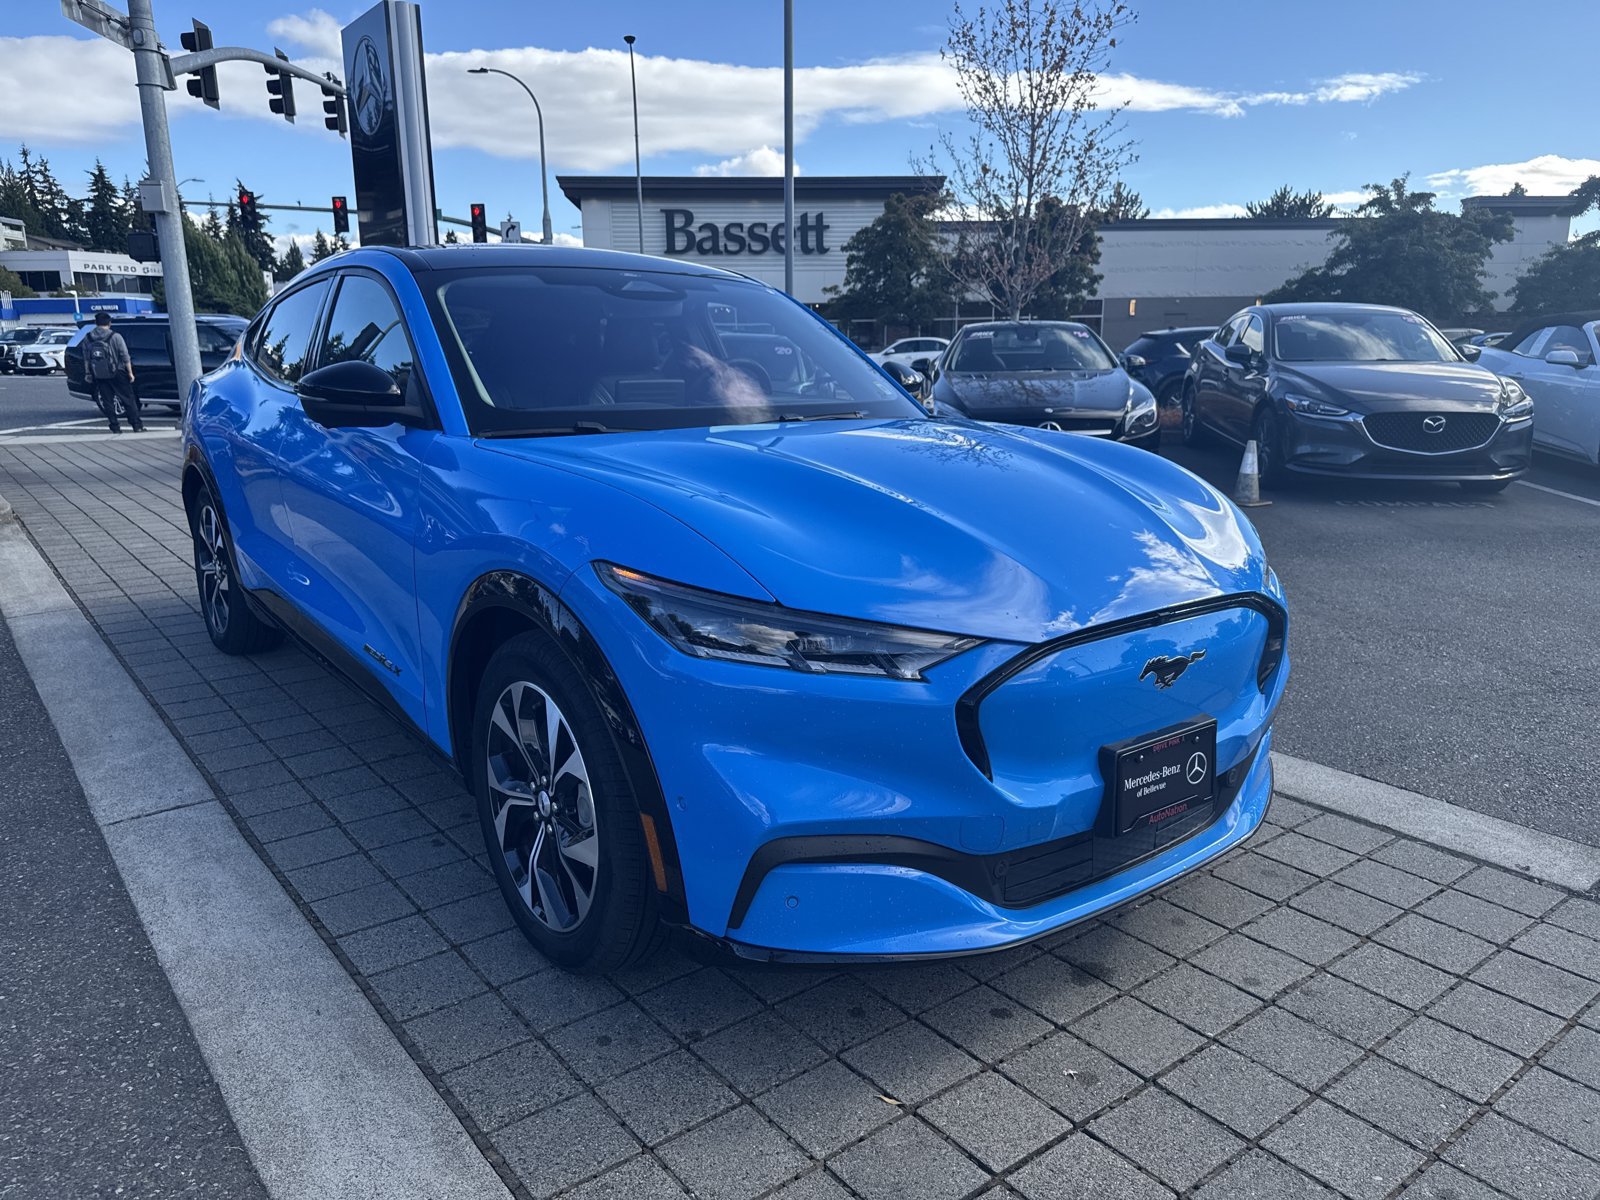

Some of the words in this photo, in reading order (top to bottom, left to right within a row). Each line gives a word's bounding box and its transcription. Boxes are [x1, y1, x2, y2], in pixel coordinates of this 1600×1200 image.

[660, 209, 830, 255] Bassett
[84, 263, 112, 271] PARK
[118, 265, 137, 273] 120
[1124, 764, 1181, 791] Mercedes-Benz
[1136, 788, 1143, 798] of
[1143, 782, 1167, 796] Bellevue
[1149, 804, 1187, 824] AutoNation
